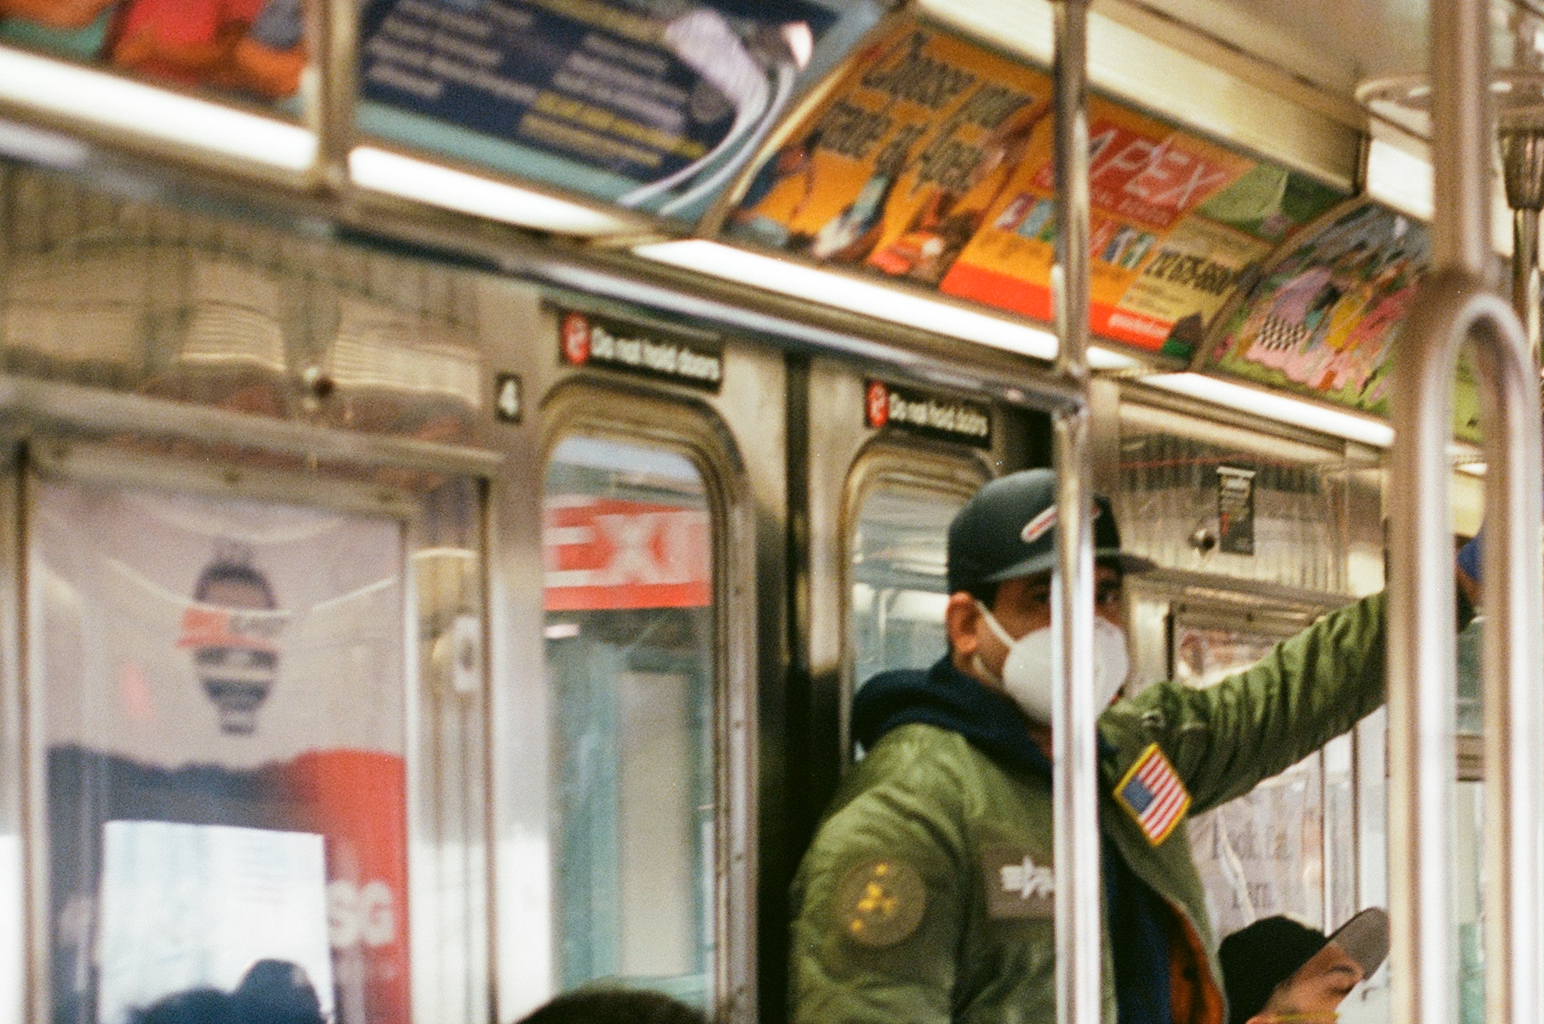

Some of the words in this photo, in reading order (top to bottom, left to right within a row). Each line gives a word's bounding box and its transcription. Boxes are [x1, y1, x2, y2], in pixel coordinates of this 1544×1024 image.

[591, 326, 615, 360] Do
[614, 338, 641, 365] not
[642, 337, 678, 373] hold
[678, 348, 721, 383] doors
[499, 379, 519, 416] 4
[928, 400, 955, 430] hold
[955, 407, 989, 437] doors
